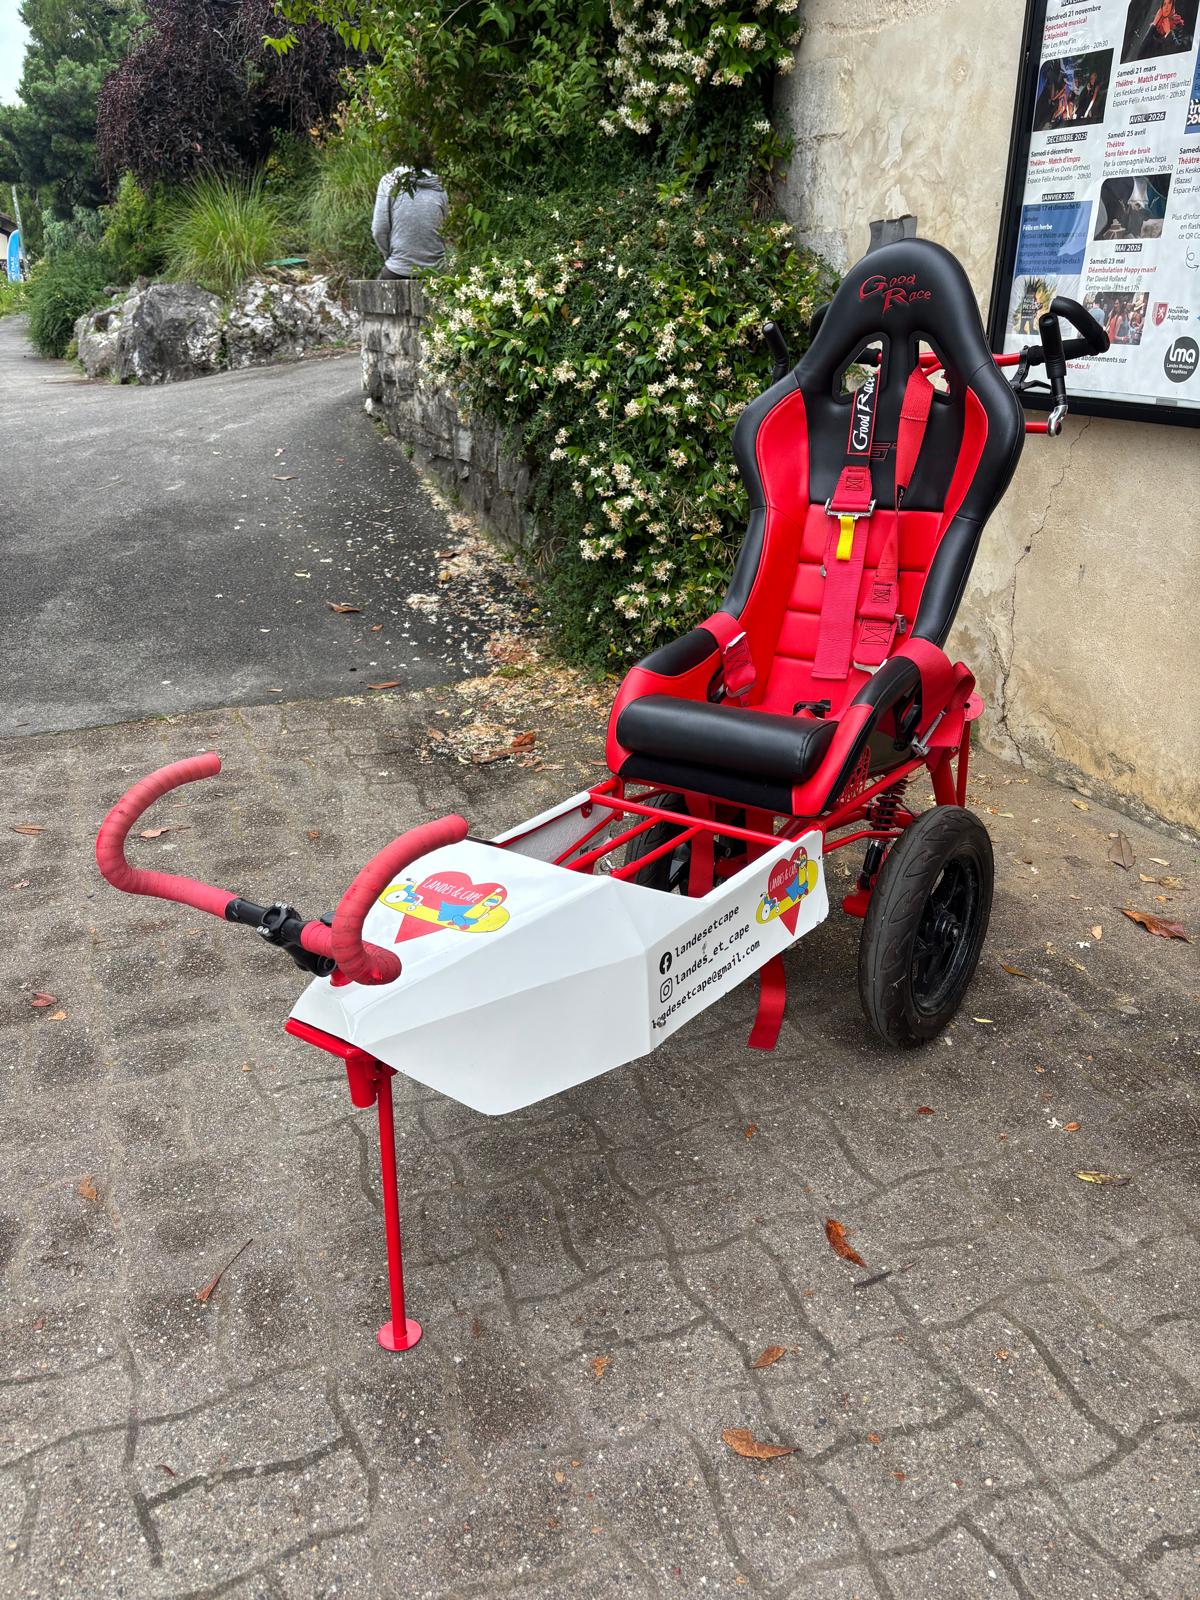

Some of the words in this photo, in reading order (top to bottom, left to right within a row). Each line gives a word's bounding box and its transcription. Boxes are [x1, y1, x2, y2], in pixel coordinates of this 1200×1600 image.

[1046, 12, 1067, 22] Vendredi
[1075, 5, 1101, 16] novembre
[1046, 21, 1068, 32] Spectacle
[1068, 16, 1088, 26] musical
[1116, 80, 1134, 88] Théâtre
[1137, 76, 1154, 84] Match
[1154, 72, 1177, 81] d'impro
[1117, 68, 1134, 78] Samedi
[1141, 94, 1166, 102] Arnaudin
[1170, 90, 1186, 98] 20h30
[1130, 115, 1146, 123] AVRIL
[1148, 112, 1166, 120] 2026
[1108, 131, 1126, 140] Samedi
[1134, 128, 1146, 136] avril
[1117, 158, 1144, 167] compagnie
[1174, 177, 1192, 185] (Bazas)
[1042, 194, 1062, 202] JANVIER
[859, 274, 916, 302] Good
[882, 288, 932, 316] Race
[1166, 314, 1188, 323] Aquitaine
[856, 376, 875, 413] Race
[852, 414, 870, 450] Good
[422, 878, 456, 894] LANDES
[450, 888, 464, 897] &
[459, 890, 483, 904] CAPE
[674, 906, 740, 958] landesetcape
[674, 924, 750, 985] landes_et_cape
